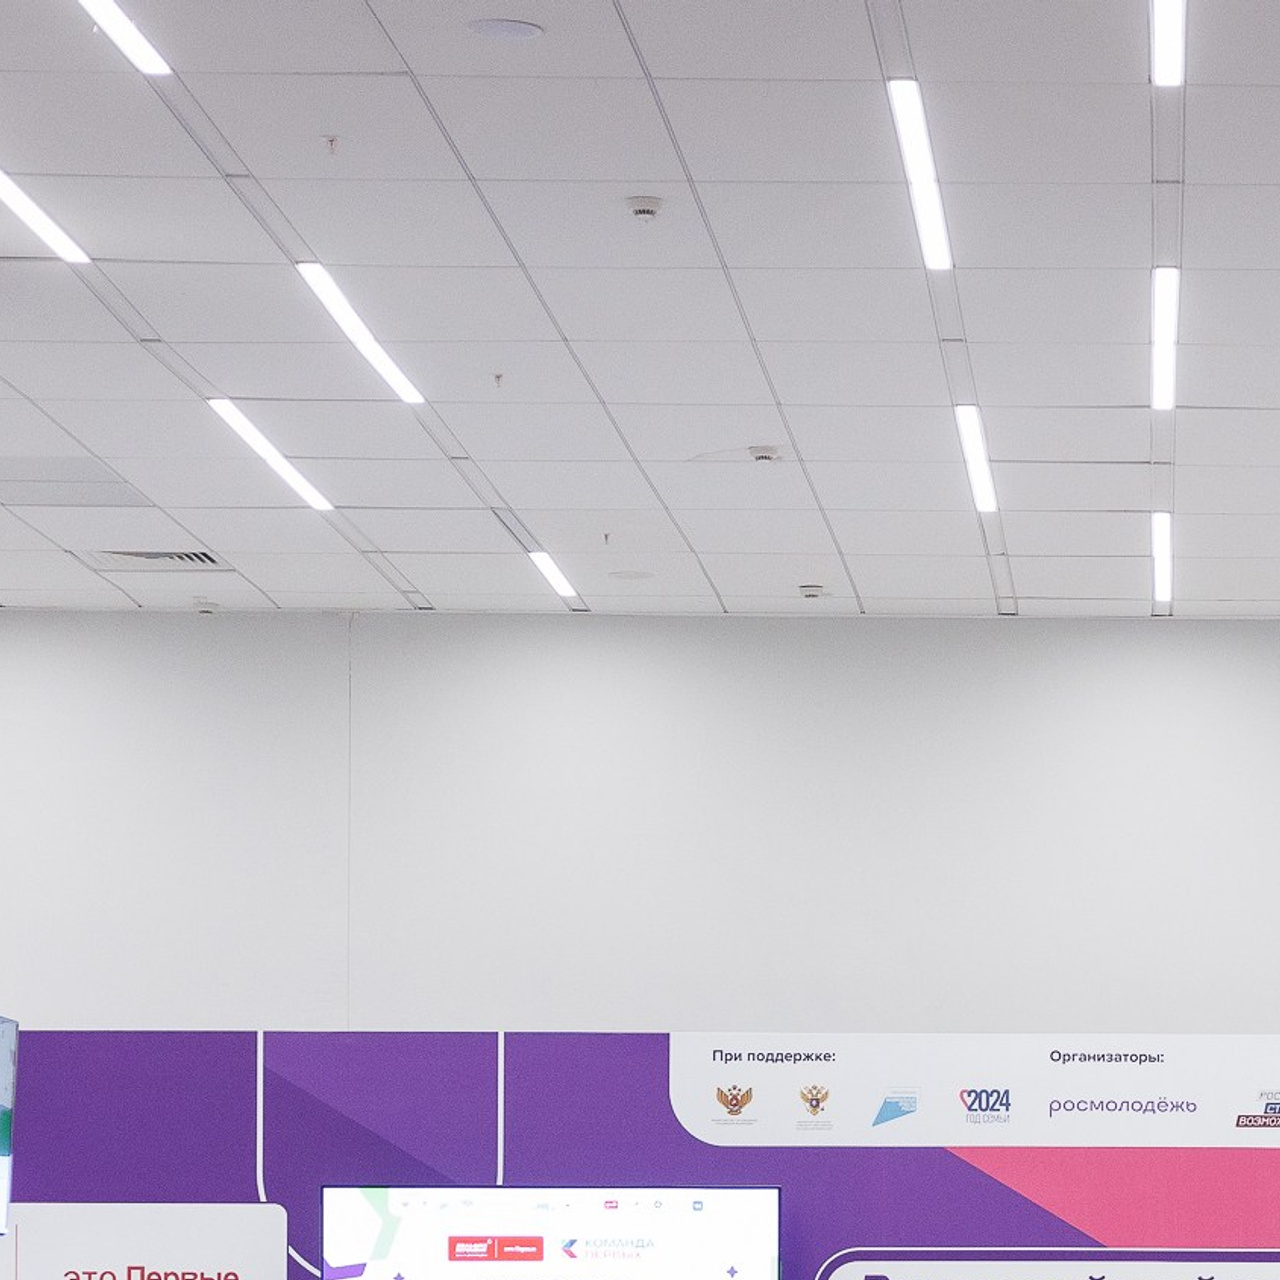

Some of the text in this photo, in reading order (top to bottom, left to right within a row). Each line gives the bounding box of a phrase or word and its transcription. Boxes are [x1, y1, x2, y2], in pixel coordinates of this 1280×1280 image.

[712, 1050, 836, 1064] При поддержке:
[1049, 1050, 1165, 1065] Организаторы:
[966, 1089, 1011, 1112] 2024
[1049, 1097, 1198, 1118] росмолодёжь
